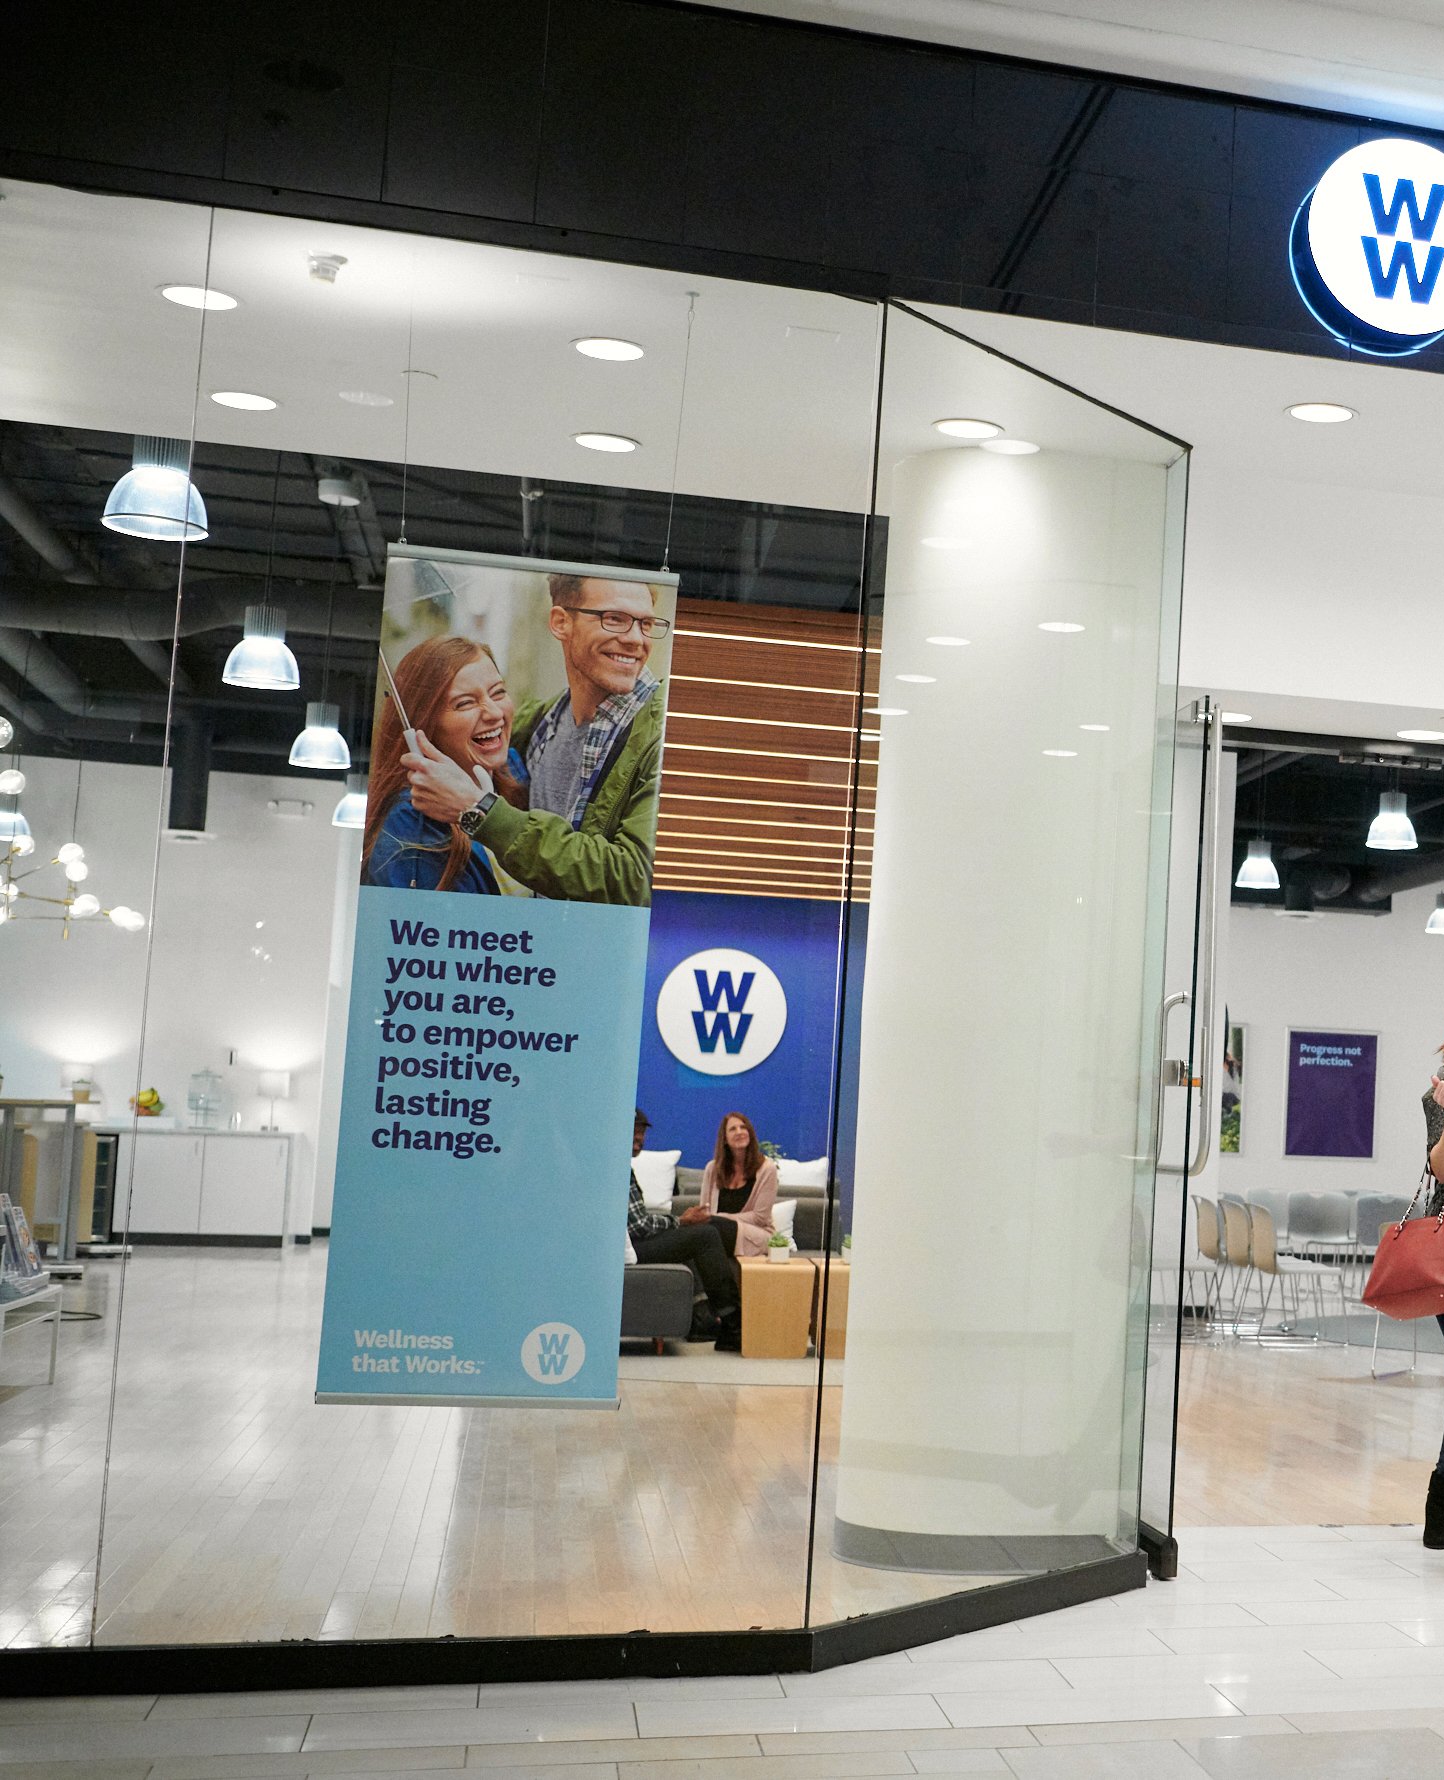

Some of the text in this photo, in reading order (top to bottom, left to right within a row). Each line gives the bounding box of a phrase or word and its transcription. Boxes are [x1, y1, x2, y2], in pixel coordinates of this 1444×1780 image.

[390, 919, 533, 954] We meet
[386, 956, 556, 987] you where
[383, 989, 514, 1021] you are,
[382, 1019, 579, 1053] to empower
[1300, 1043, 1362, 1056] Progress not
[377, 1052, 520, 1087] positive,
[1299, 1056, 1353, 1066] perfection.
[375, 1087, 492, 1125] lasting
[371, 1122, 502, 1159] change.
[354, 1329, 453, 1350] Wellness
[352, 1353, 399, 1373] that
